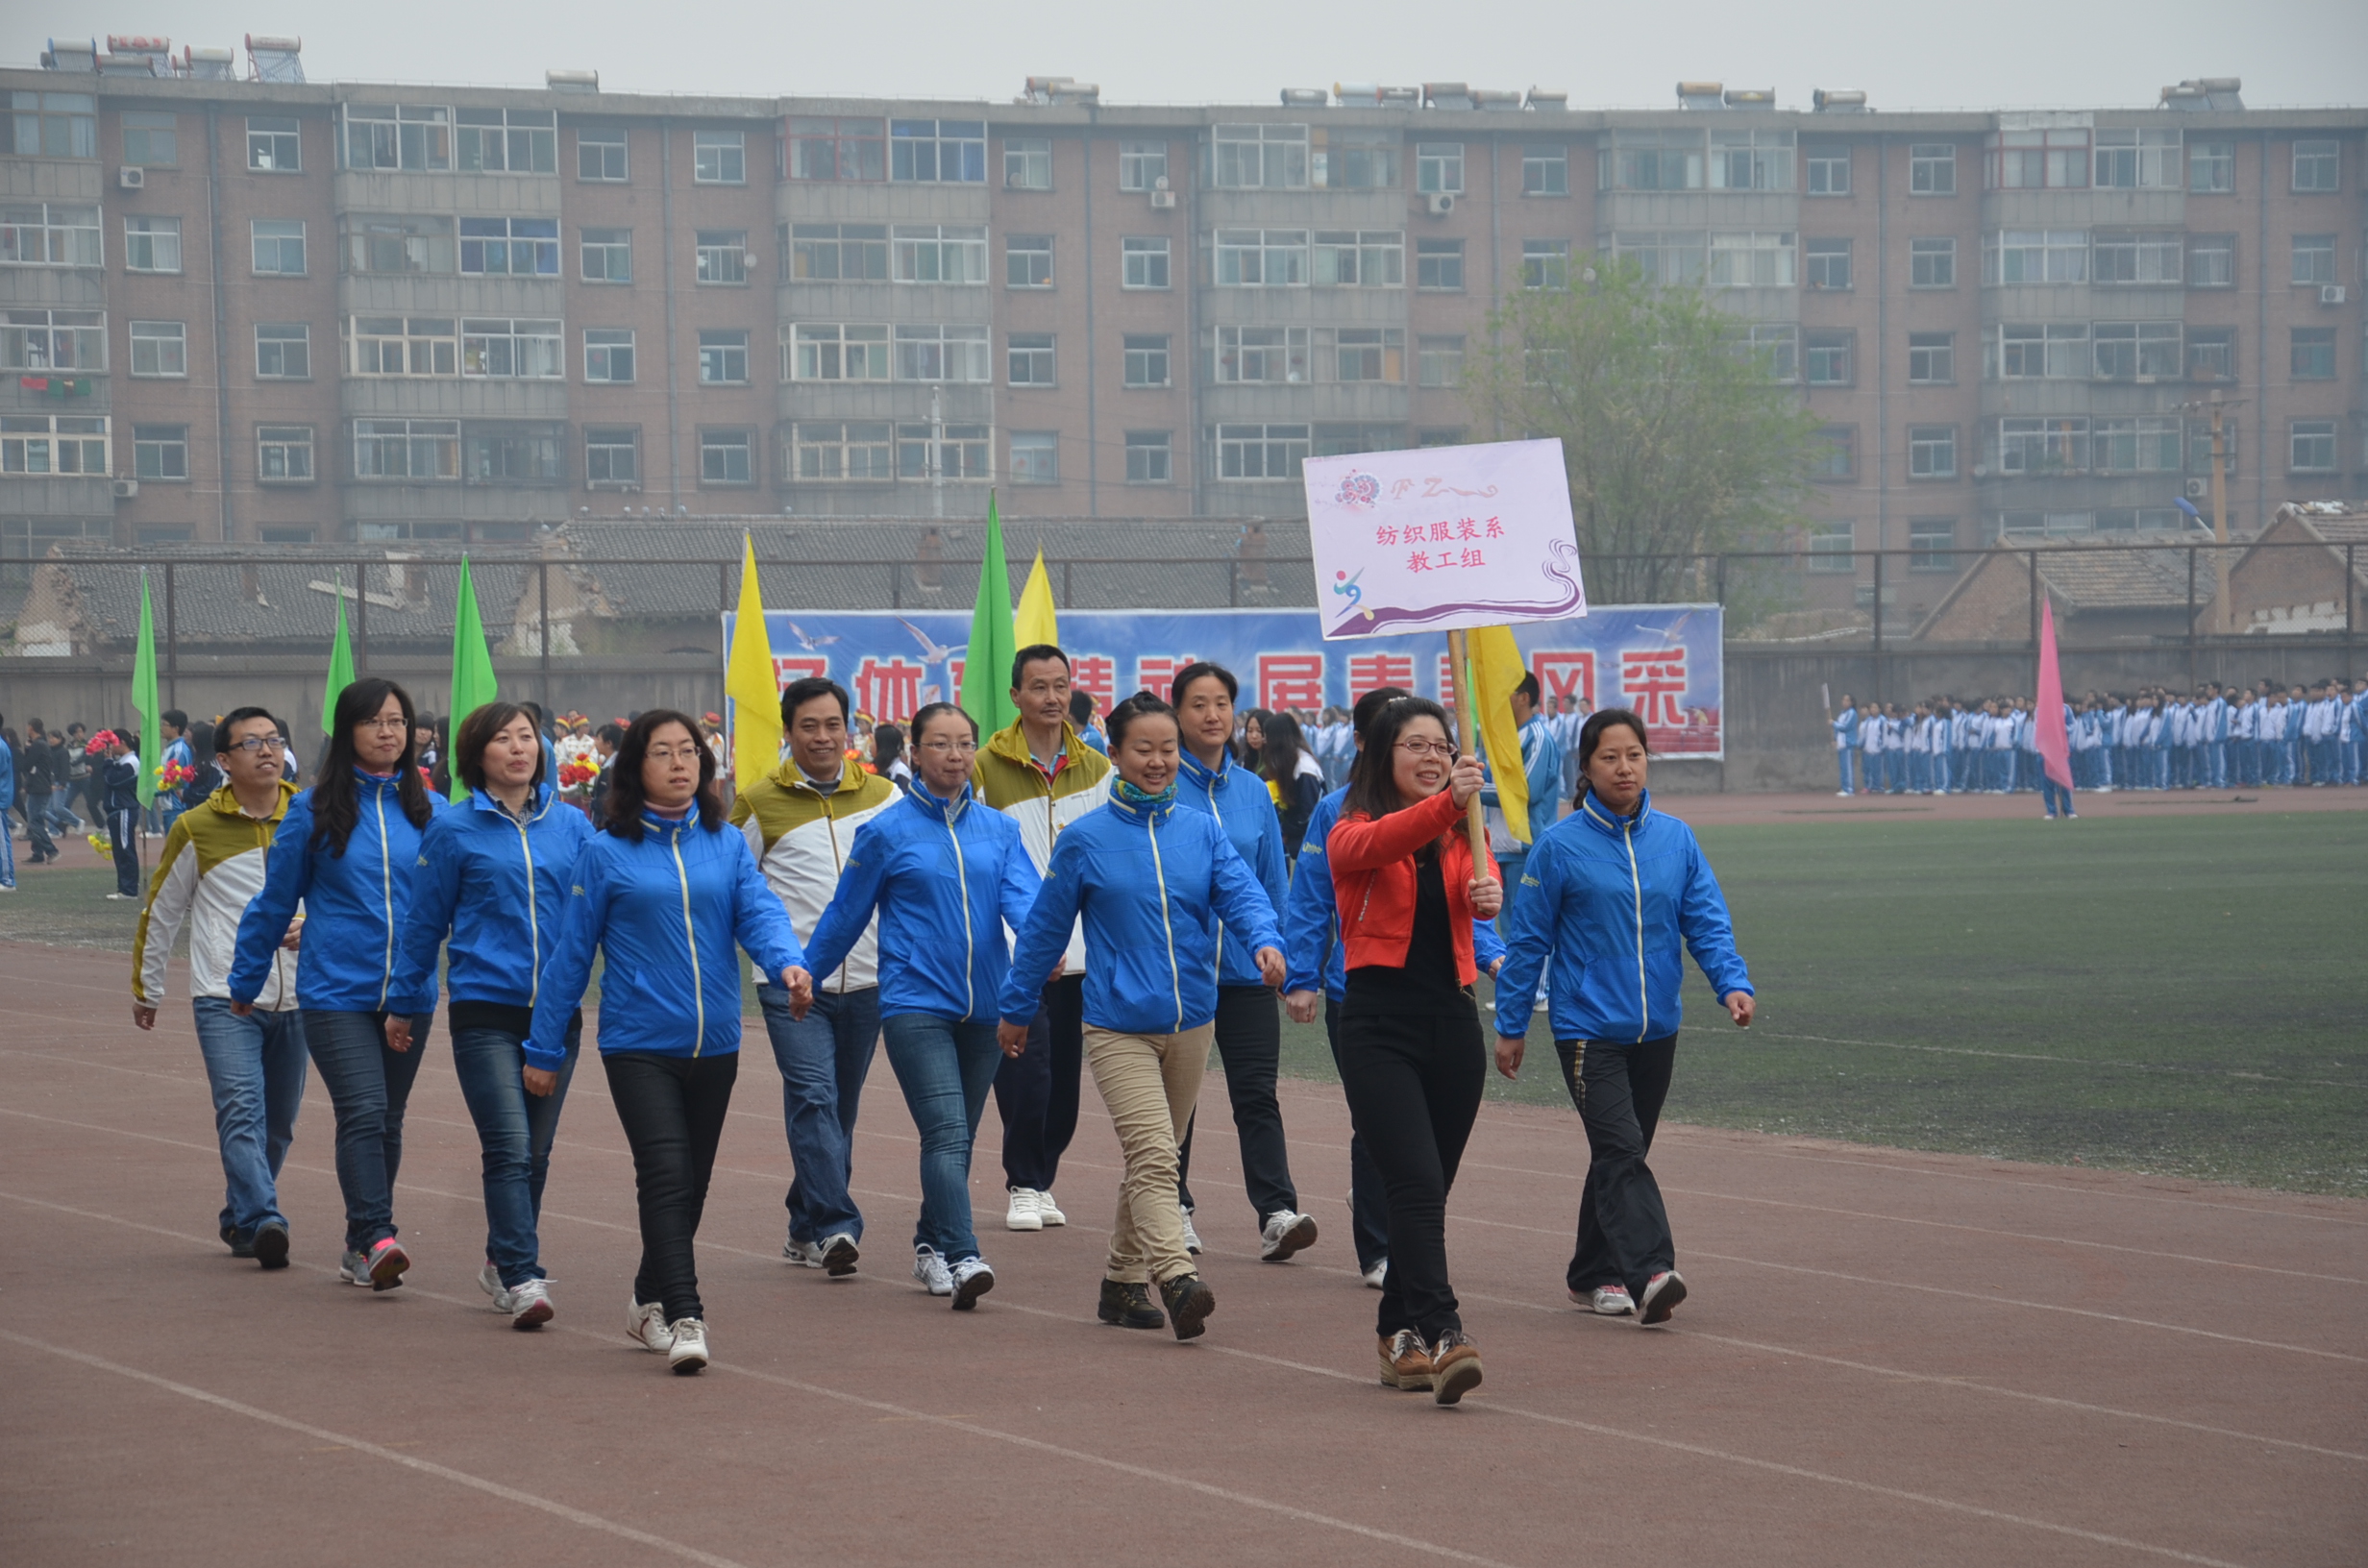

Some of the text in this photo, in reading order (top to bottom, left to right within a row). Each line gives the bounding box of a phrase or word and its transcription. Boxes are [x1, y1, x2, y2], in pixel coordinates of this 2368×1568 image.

[1375, 516, 1505, 546] 纺织服装系
[1406, 548, 1486, 574] 教工组
